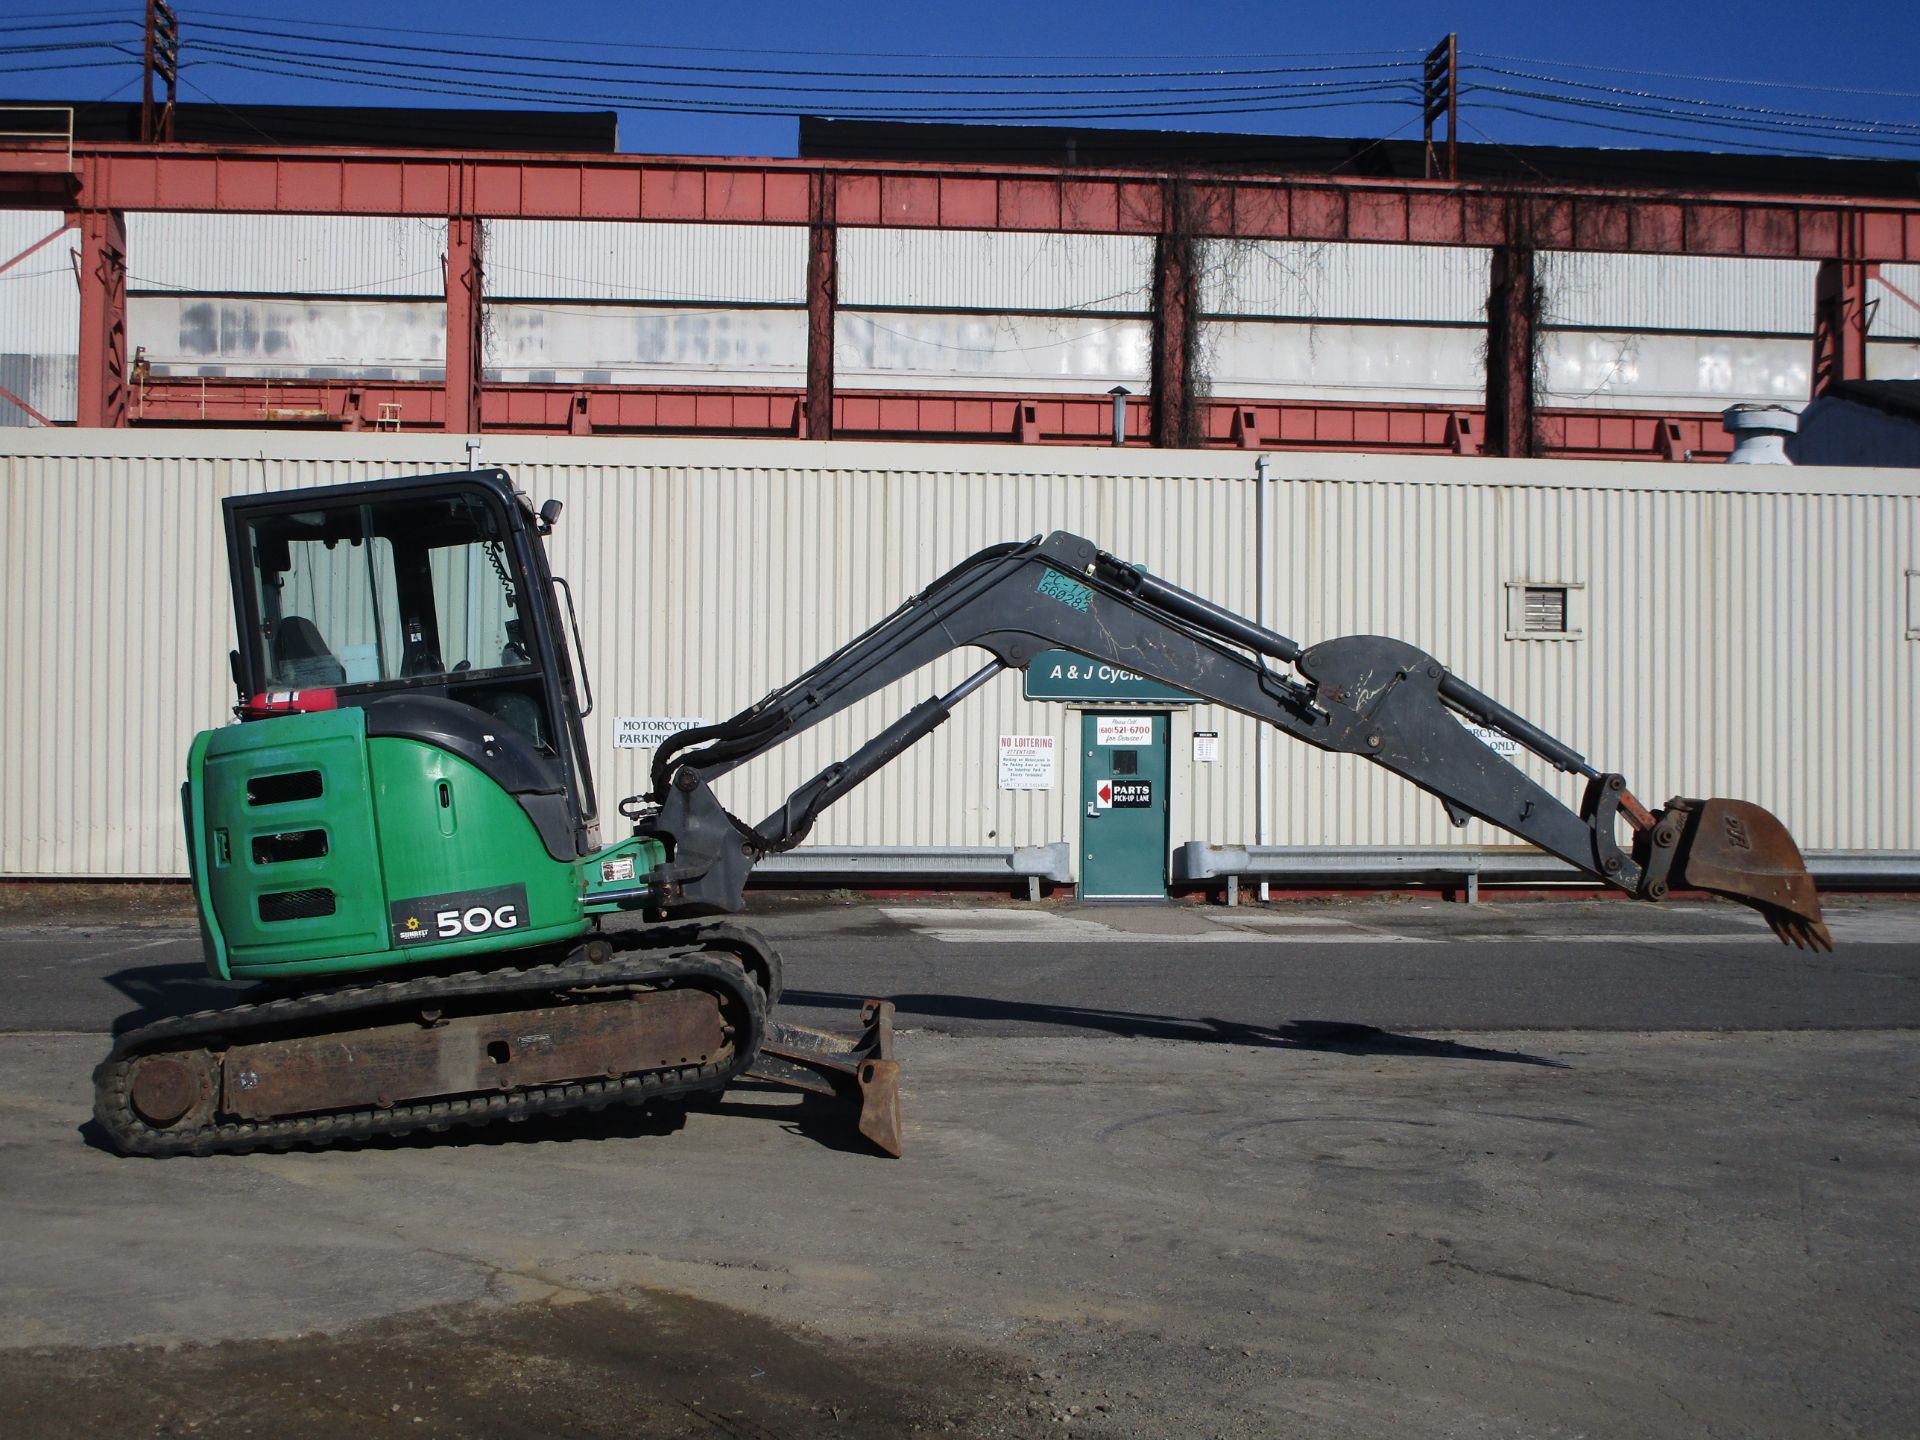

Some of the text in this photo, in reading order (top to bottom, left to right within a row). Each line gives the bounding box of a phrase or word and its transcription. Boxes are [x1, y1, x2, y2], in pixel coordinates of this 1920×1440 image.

[1050, 665, 1062, 679] A
[1067, 665, 1078, 679] &
[1084, 666, 1094, 680] J
[623, 721, 700, 731] MOTORCYCLE
[1001, 738, 1053, 748] NO LOITERING
[1490, 741, 1516, 751] ONLY
[1113, 785, 1150, 795] PARTS
[1113, 794, 1150, 802] PICK-UP LANE
[437, 906, 517, 937] 50G
